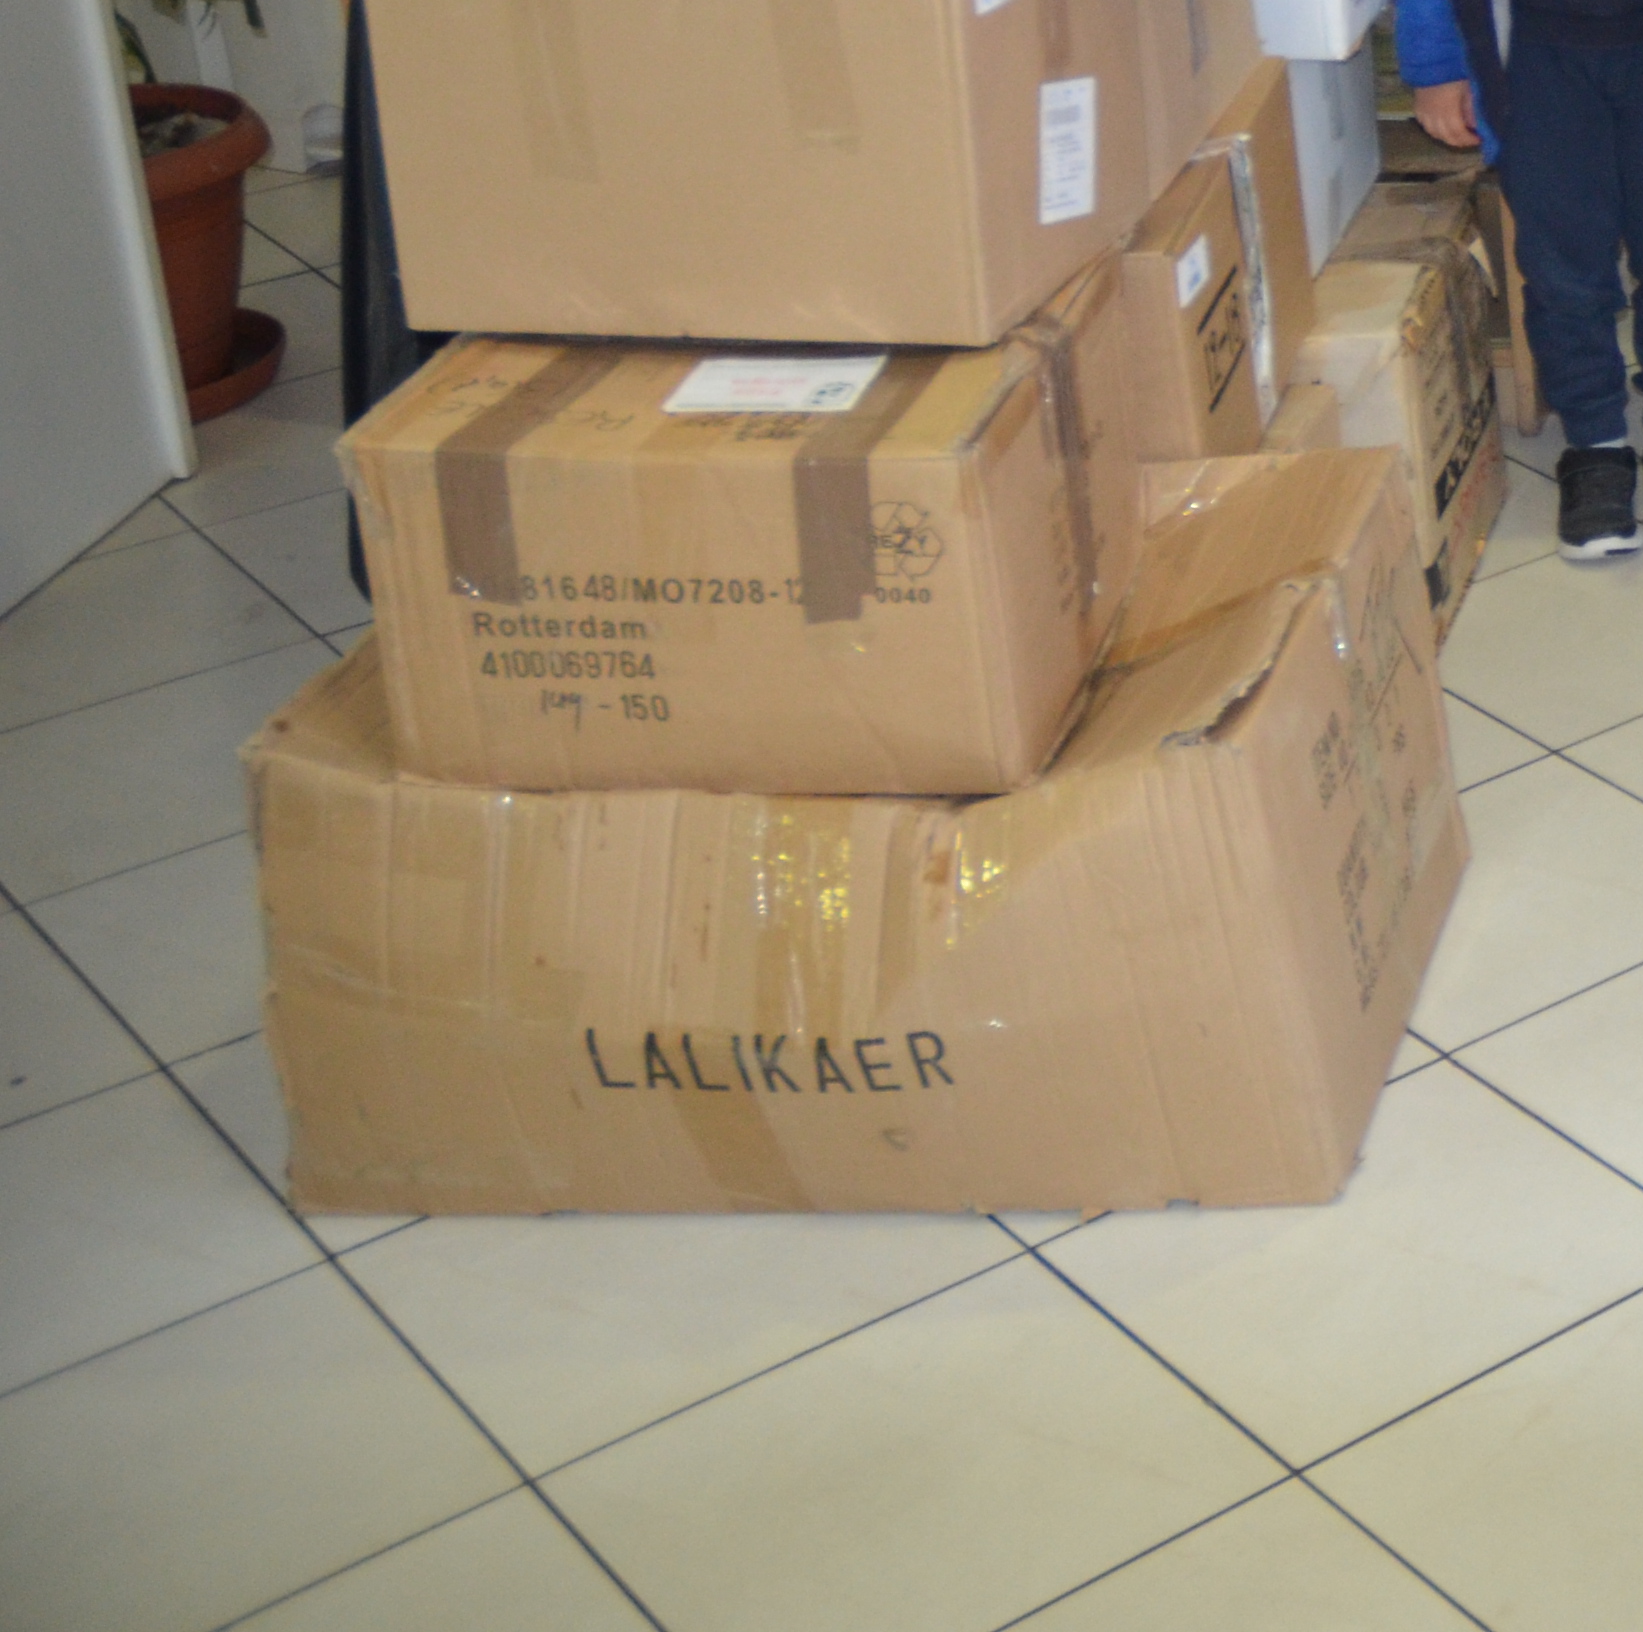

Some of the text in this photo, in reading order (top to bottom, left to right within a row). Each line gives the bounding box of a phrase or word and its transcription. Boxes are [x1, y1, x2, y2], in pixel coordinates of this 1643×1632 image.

[472, 612, 648, 640] Rotterdam
[481, 650, 656, 679] 4100069764
[584, 1027, 955, 1094] LALIKAER
